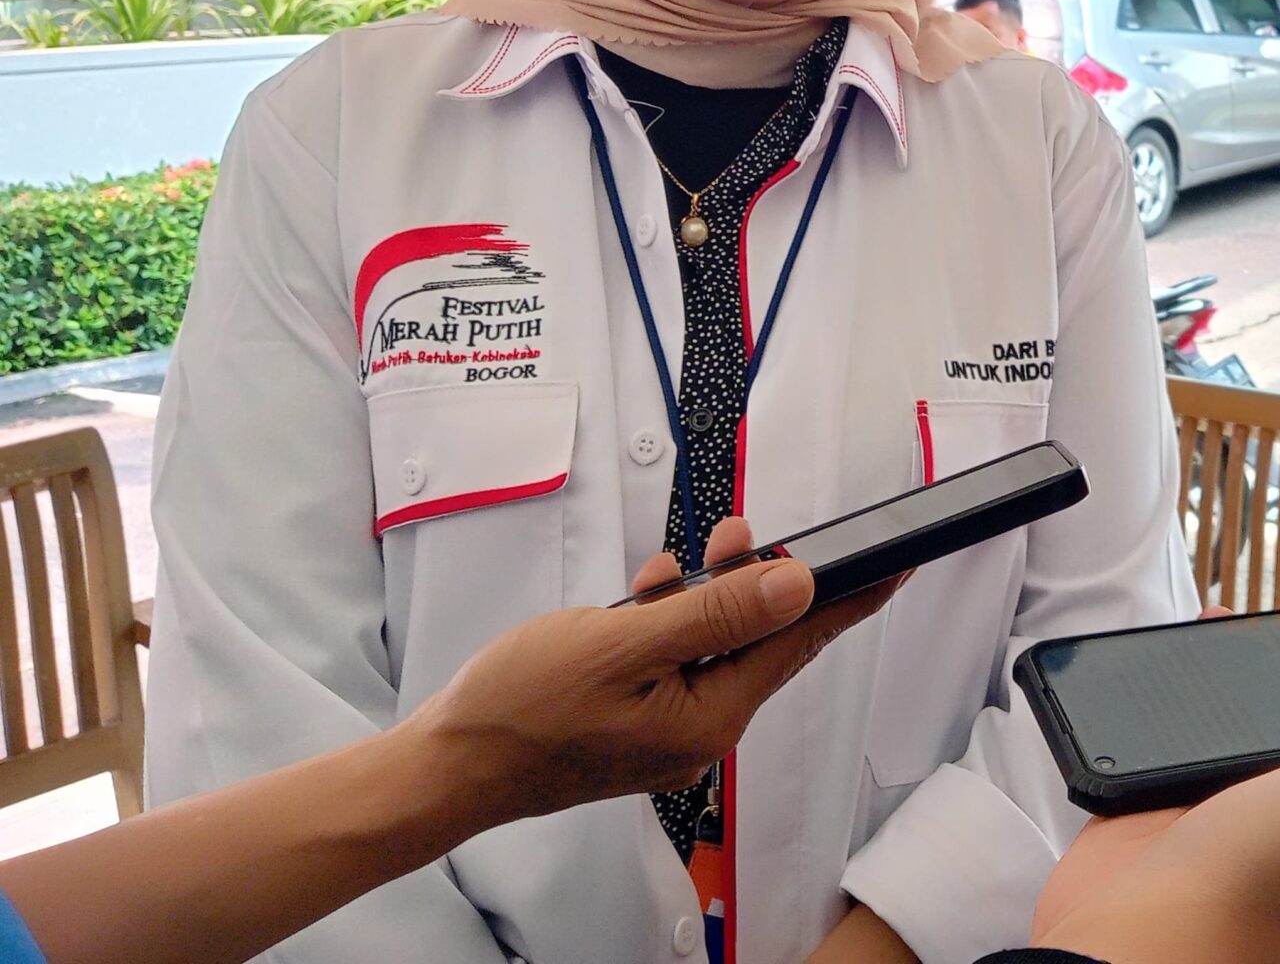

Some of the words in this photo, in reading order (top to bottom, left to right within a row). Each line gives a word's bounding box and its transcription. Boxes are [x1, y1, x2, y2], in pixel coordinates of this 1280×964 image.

[441, 296, 545, 320] FESTIVAL
[379, 318, 459, 352] MERAH
[467, 318, 542, 347] PUTIH
[992, 340, 1039, 361] DARI
[1045, 339, 1055, 357] B
[463, 364, 538, 382] BOGOR
[944, 360, 1002, 383] UNTUK
[1005, 361, 1052, 383] INDO
